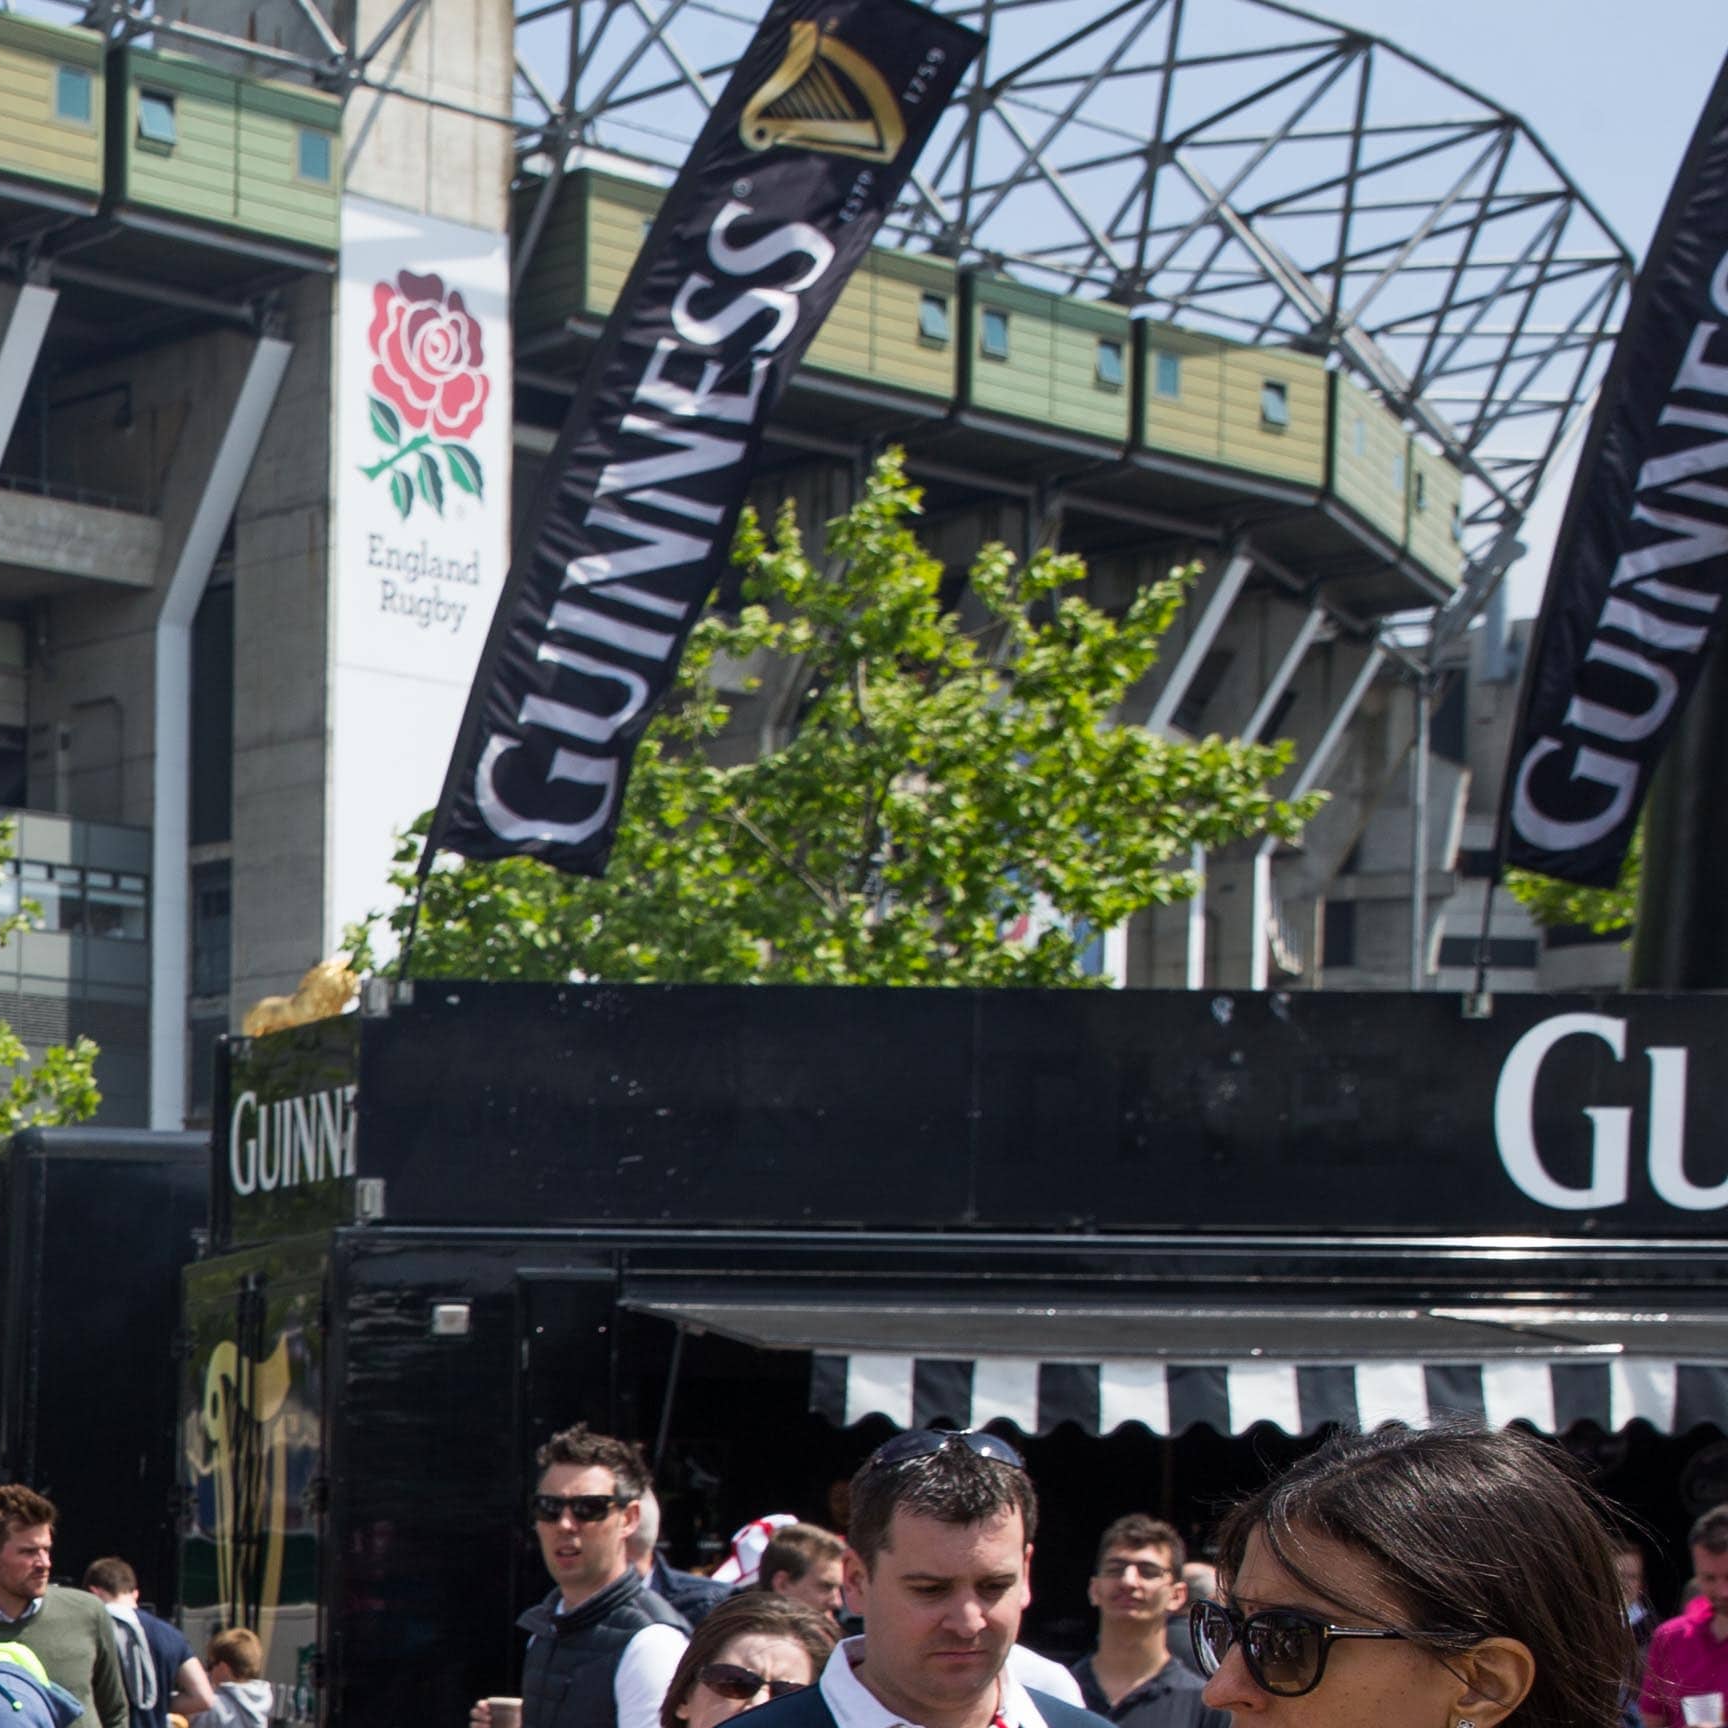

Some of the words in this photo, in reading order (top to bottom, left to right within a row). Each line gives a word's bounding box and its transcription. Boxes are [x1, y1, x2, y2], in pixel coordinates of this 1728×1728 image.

[474, 198, 837, 847] GUINNESS
[367, 533, 481, 586] England
[378, 579, 469, 633] Rugby
